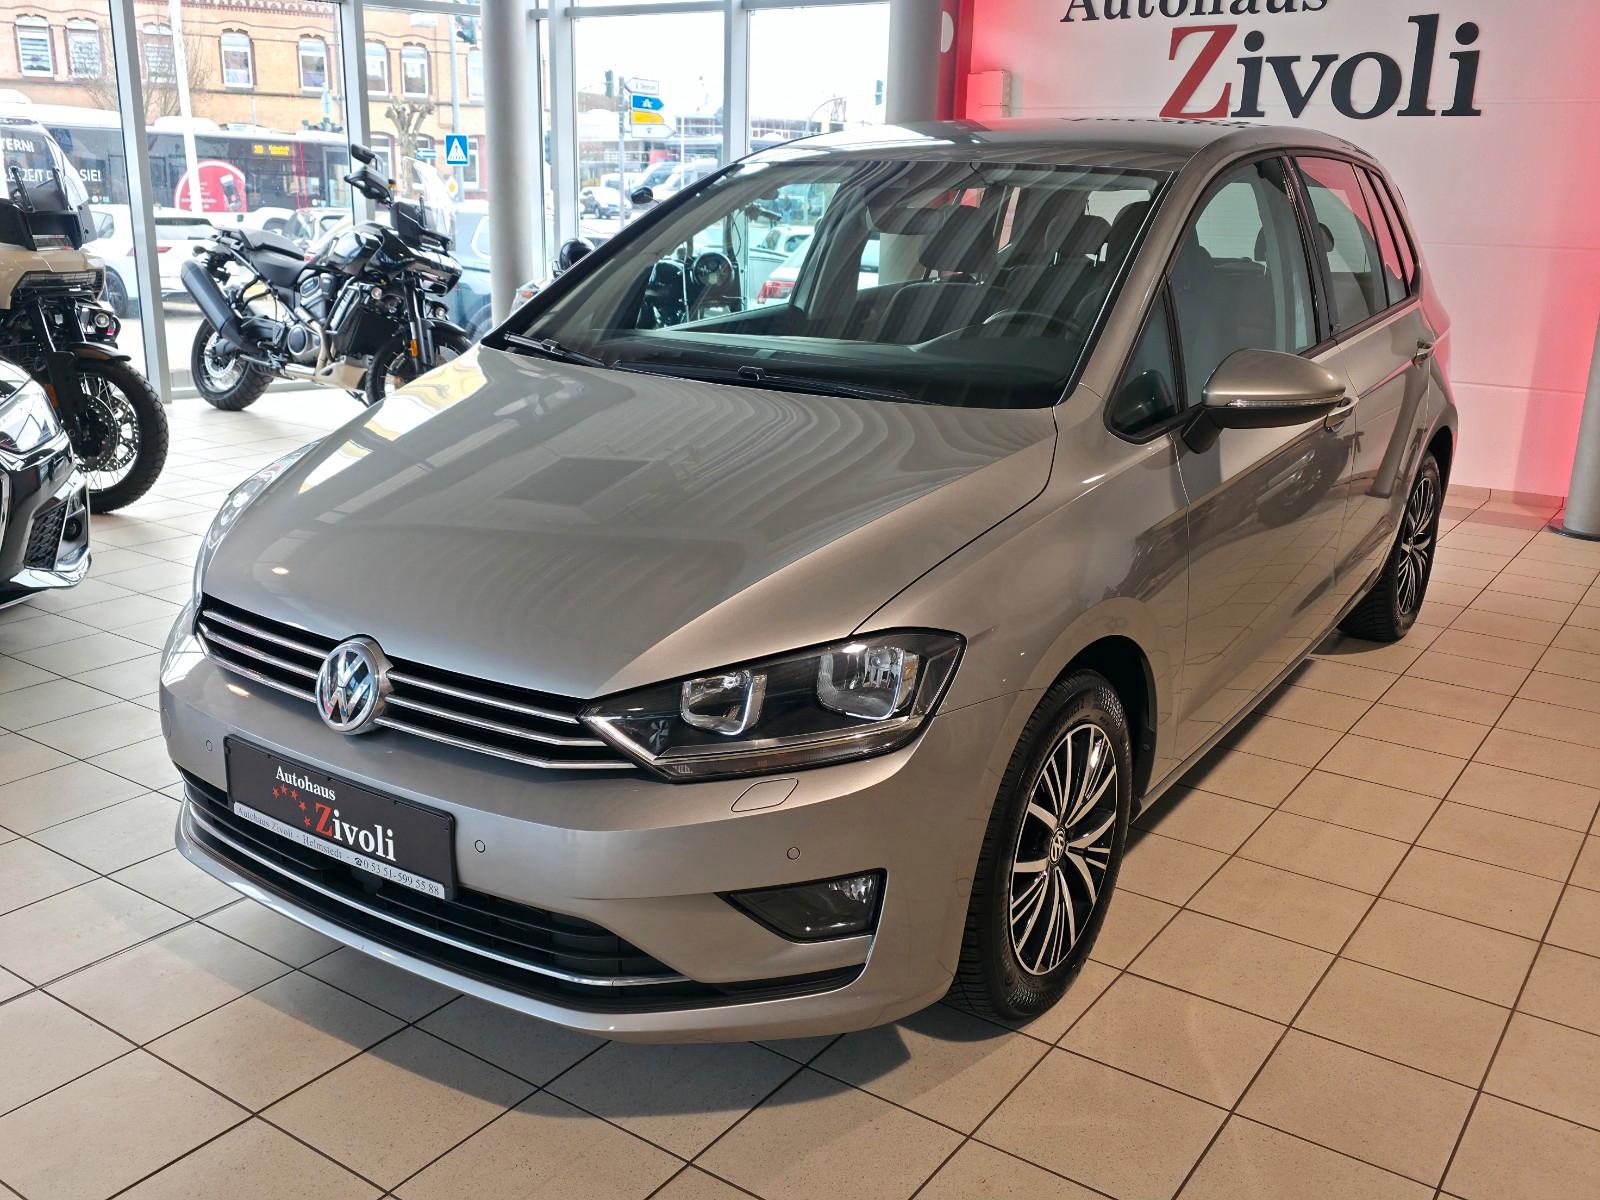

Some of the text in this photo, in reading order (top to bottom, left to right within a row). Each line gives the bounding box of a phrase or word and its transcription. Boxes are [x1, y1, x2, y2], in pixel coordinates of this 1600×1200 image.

[1159, 13, 1481, 119] Zivoli
[79, 168, 102, 182] SIE!
[275, 765, 336, 801] Autohaus
[238, 807, 270, 828] Autohaus
[271, 822, 294, 838] Zivoli
[303, 834, 342, 857] Helmstedt
[315, 801, 397, 862] Zivoli
